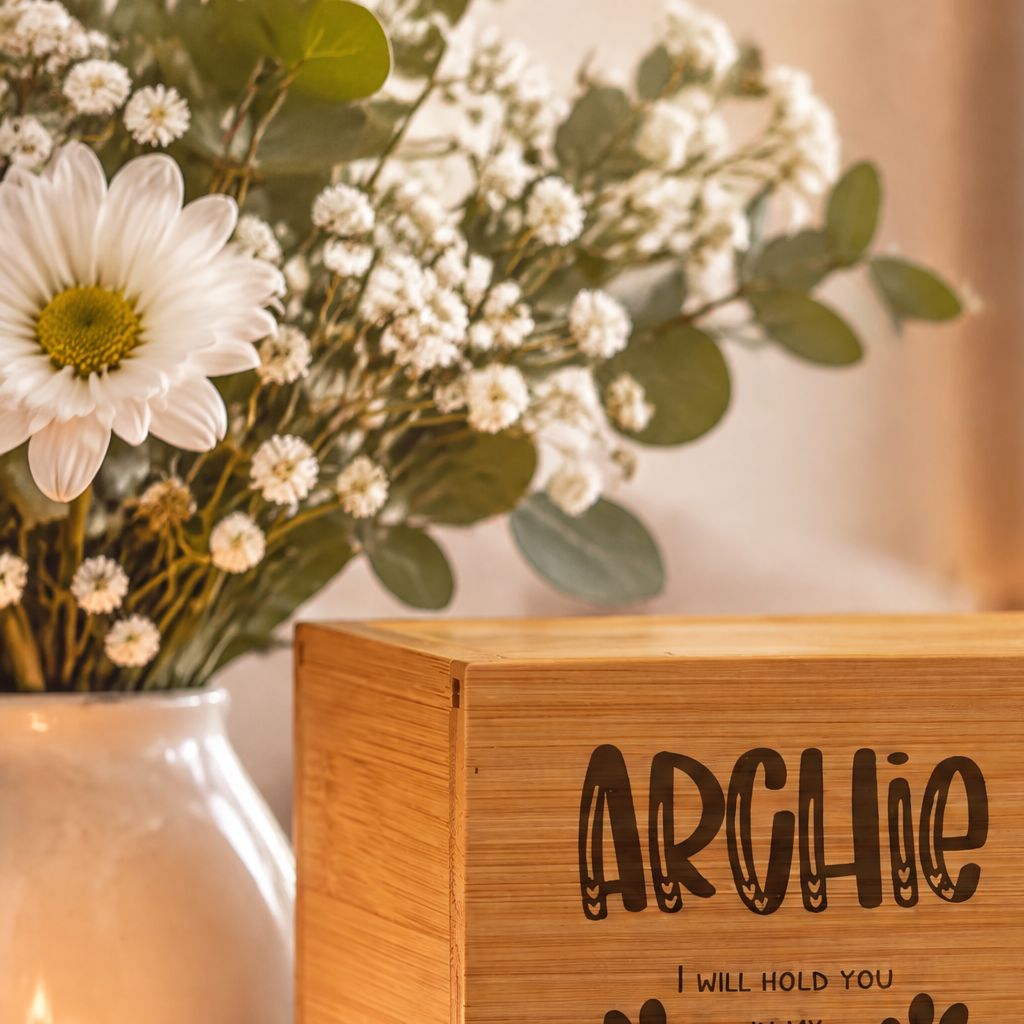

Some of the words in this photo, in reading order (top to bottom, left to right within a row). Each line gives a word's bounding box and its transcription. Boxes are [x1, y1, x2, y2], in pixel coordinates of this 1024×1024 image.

[678, 965, 684, 993] I
[696, 972, 751, 993] WILL
[761, 971, 829, 992] HOLD
[840, 969, 893, 990] YOU
